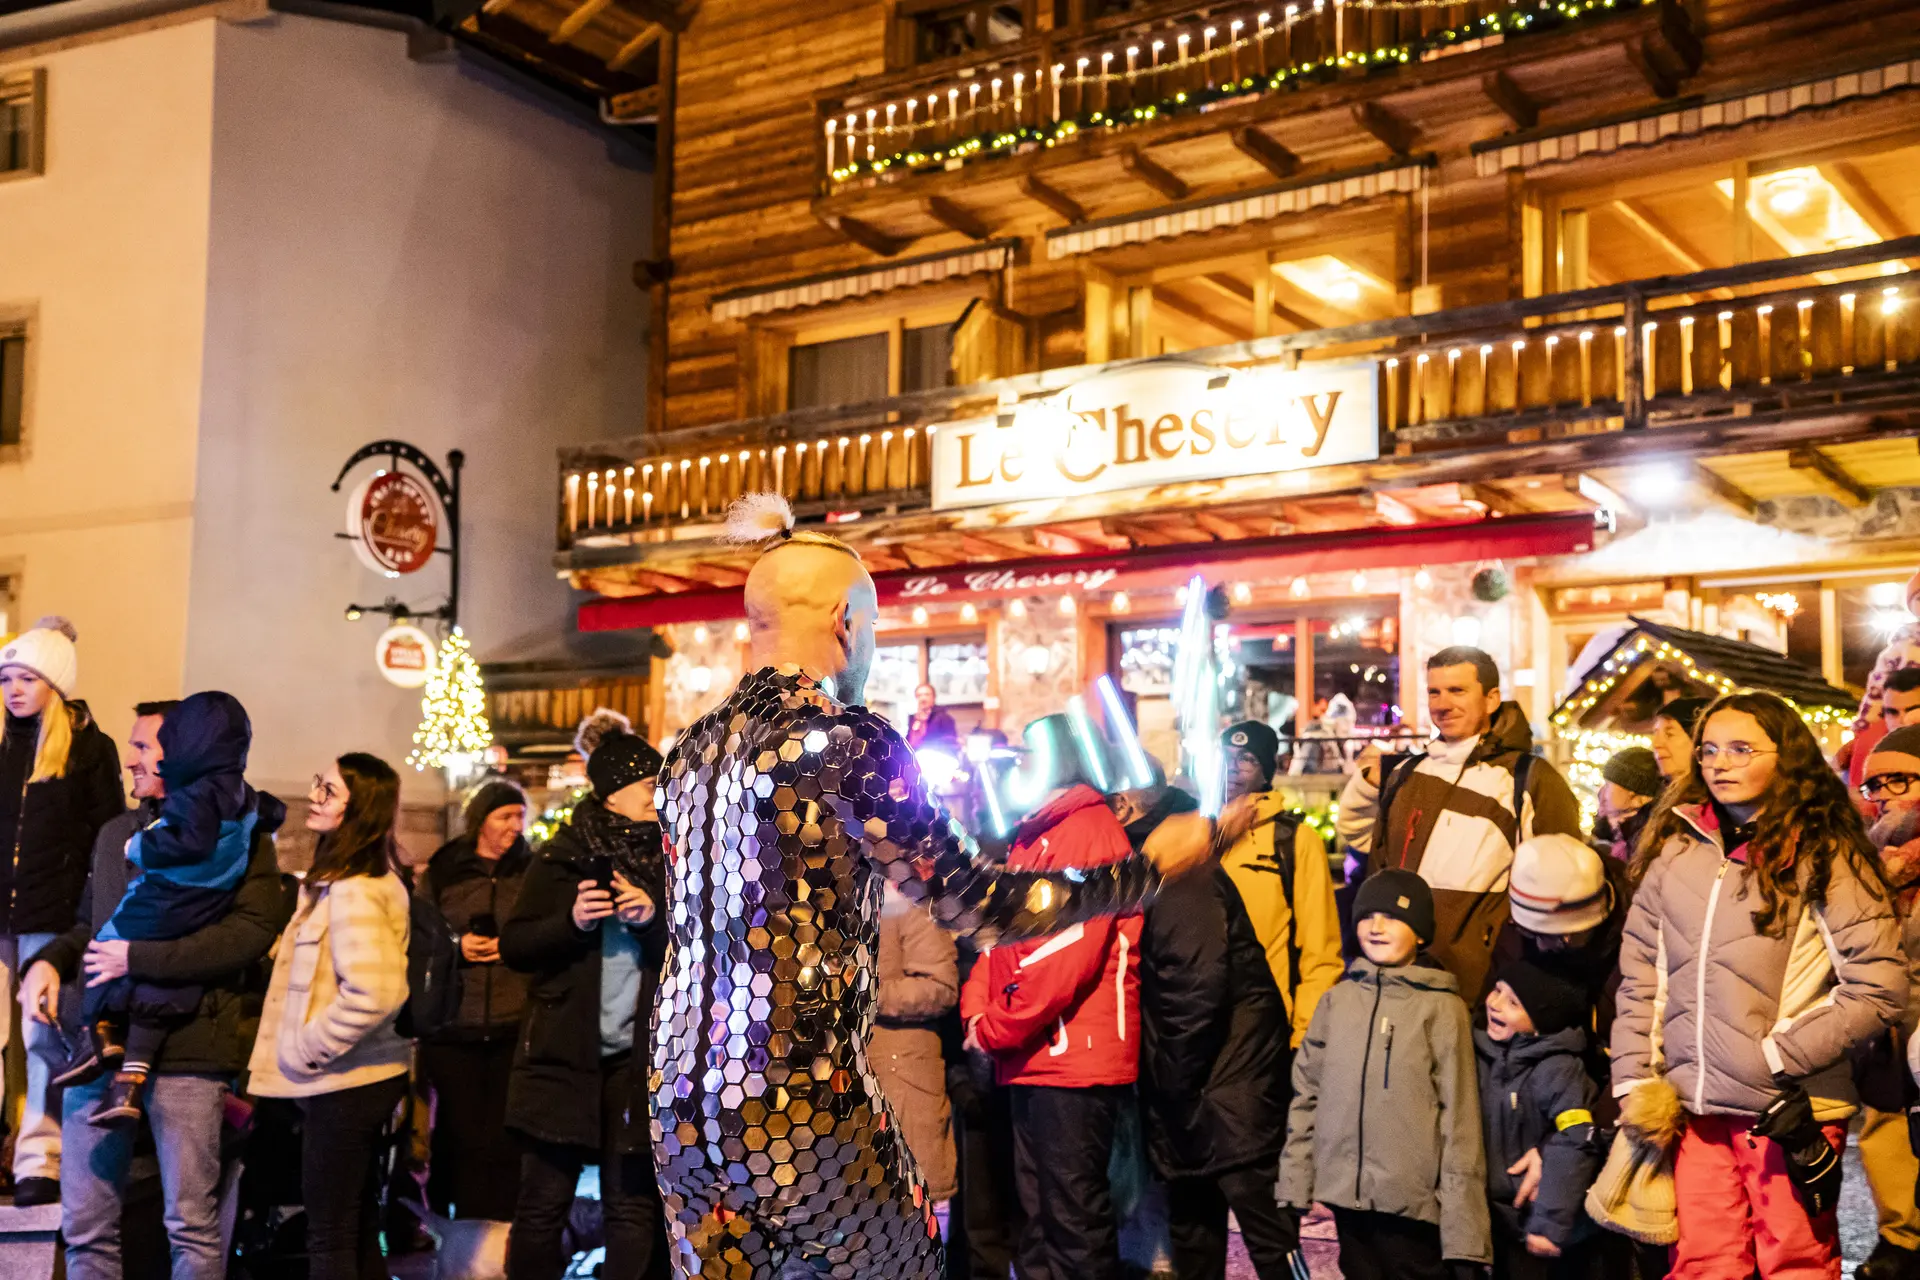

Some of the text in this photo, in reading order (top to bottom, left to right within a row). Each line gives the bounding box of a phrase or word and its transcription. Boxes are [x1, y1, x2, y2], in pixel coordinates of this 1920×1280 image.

[956, 433, 1024, 488] Le
[899, 568, 1117, 597] Le Chesery
